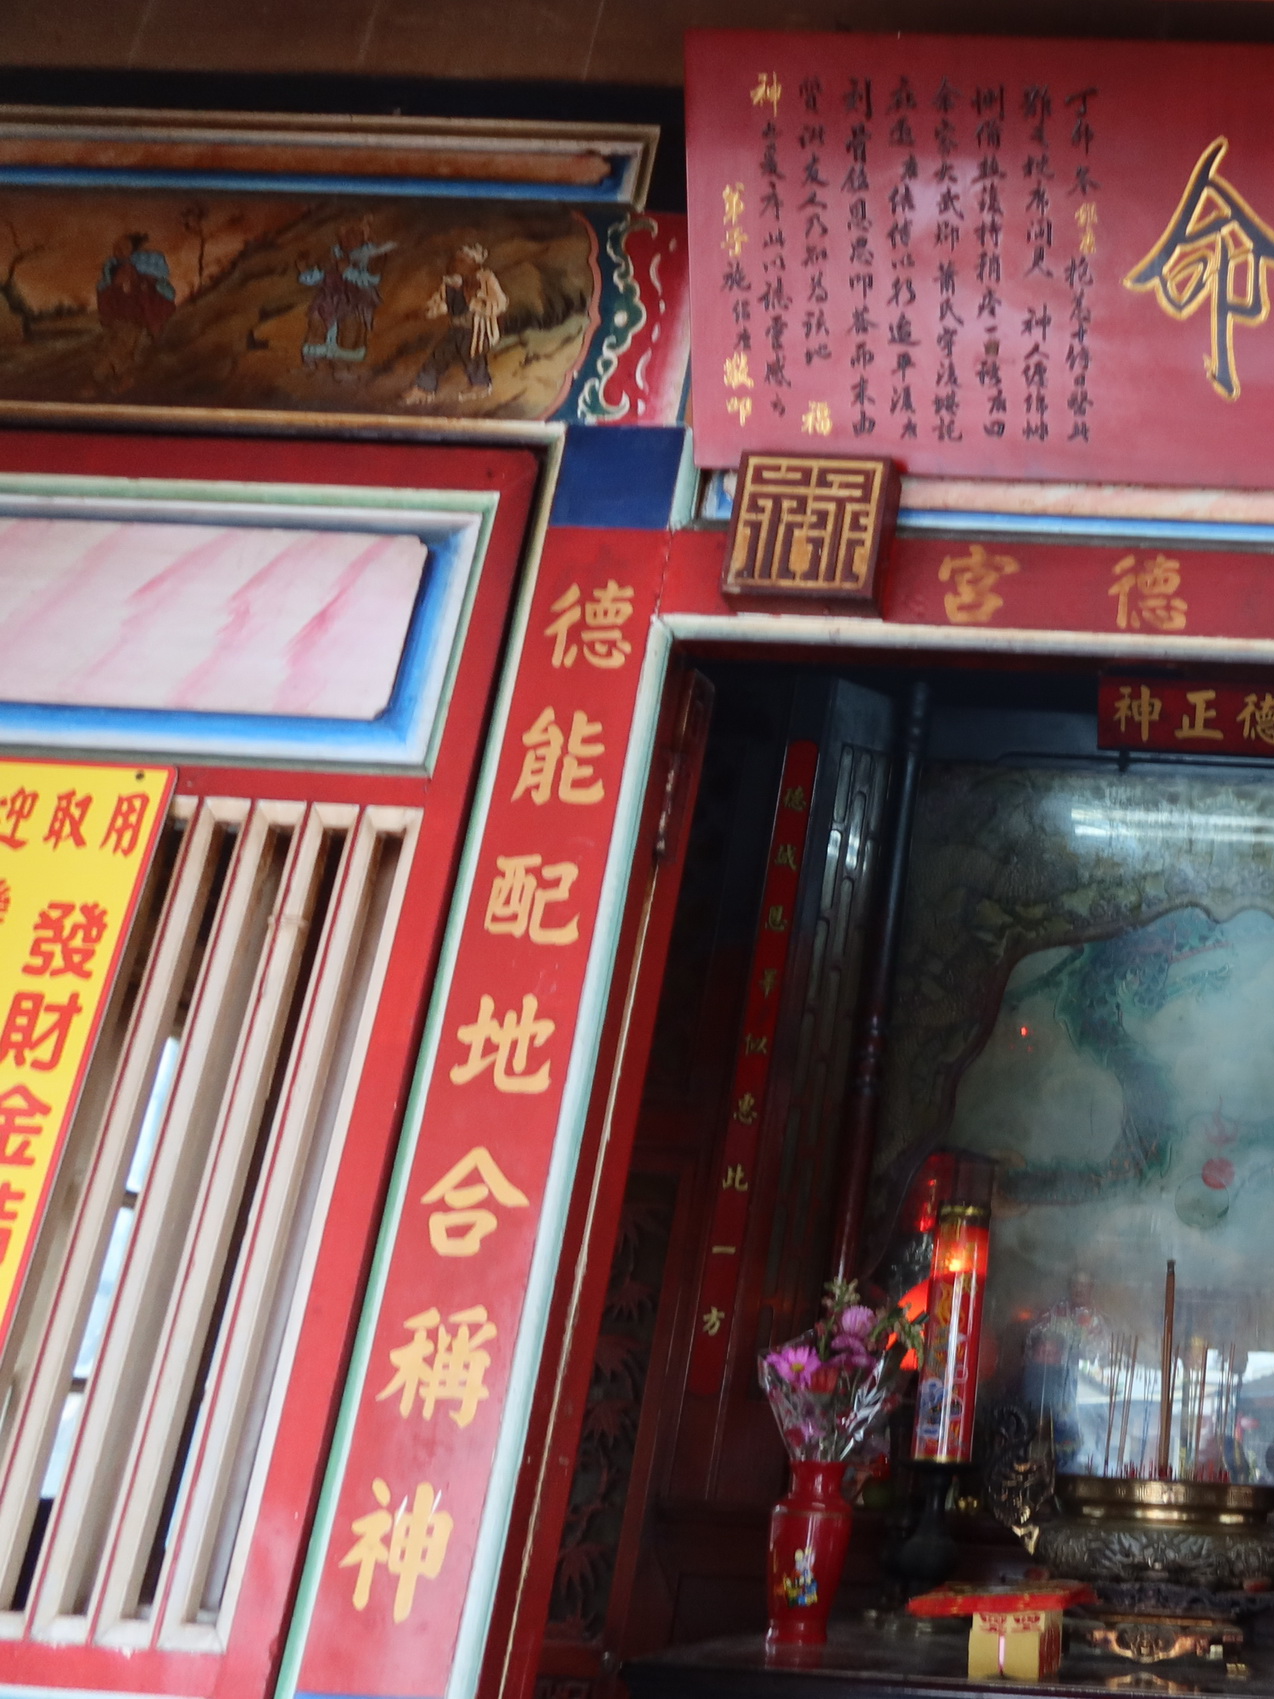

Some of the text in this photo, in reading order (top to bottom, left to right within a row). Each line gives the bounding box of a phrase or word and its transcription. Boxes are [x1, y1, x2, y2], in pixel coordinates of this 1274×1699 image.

[338, 578, 635, 1623] 德能配地合稱神
